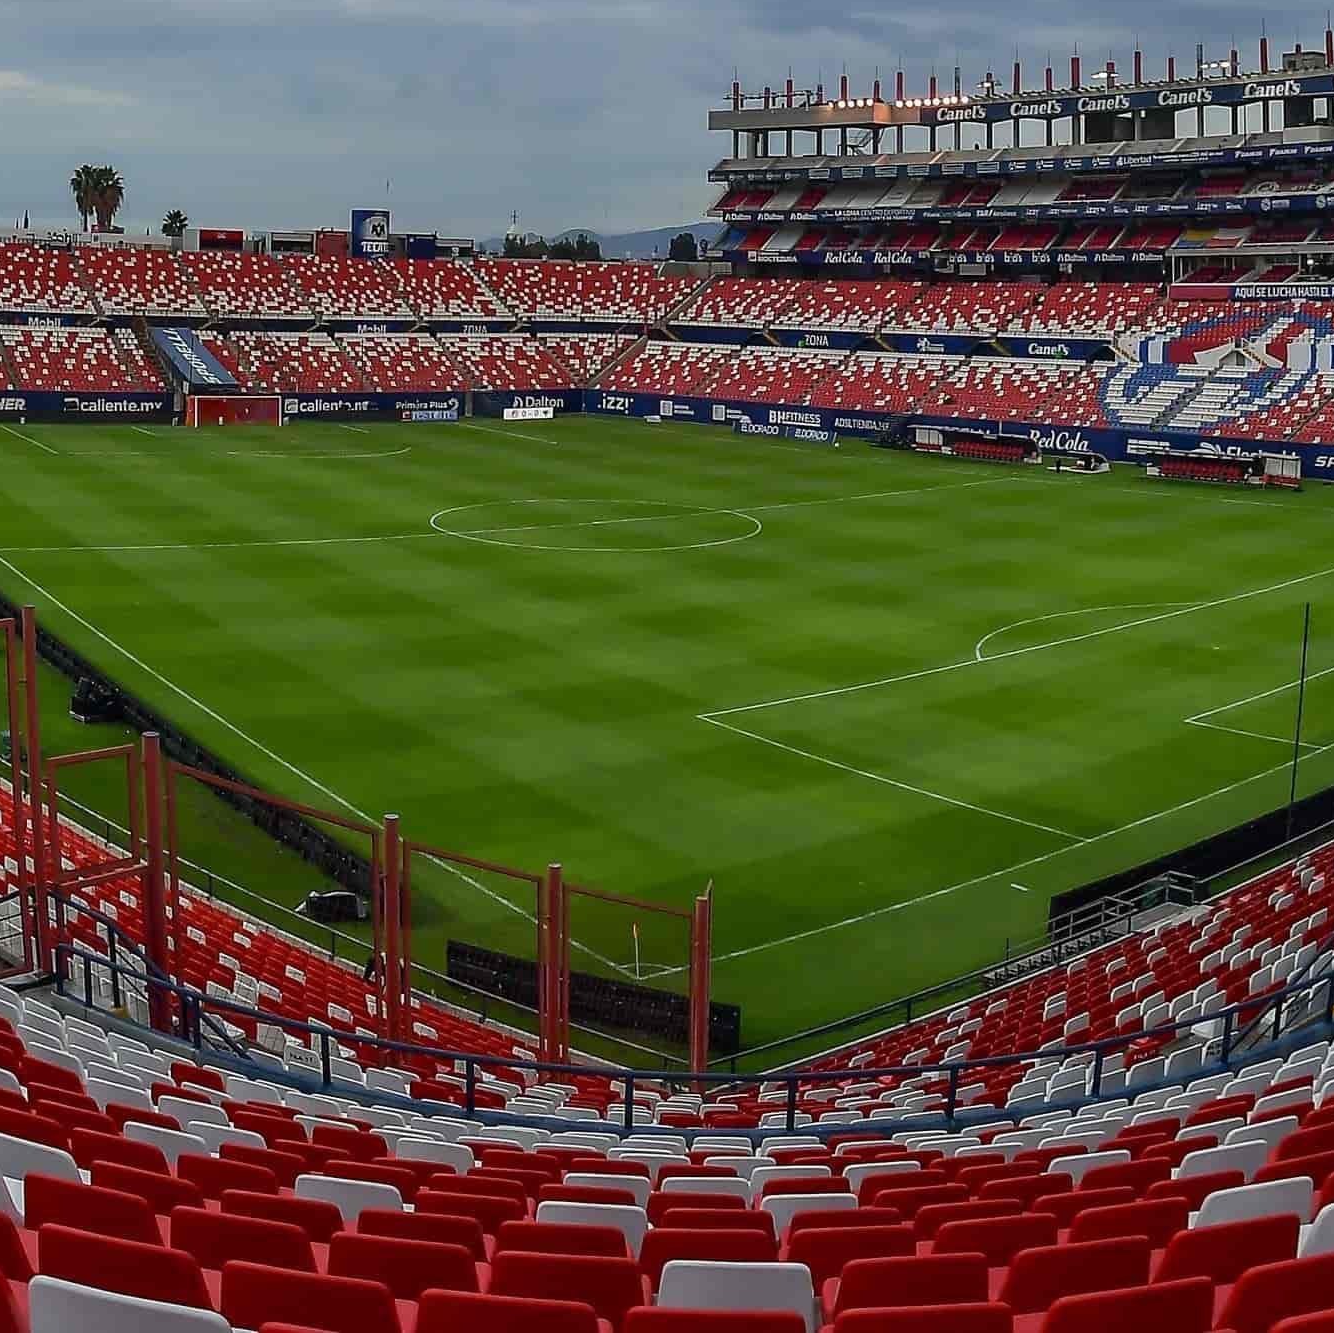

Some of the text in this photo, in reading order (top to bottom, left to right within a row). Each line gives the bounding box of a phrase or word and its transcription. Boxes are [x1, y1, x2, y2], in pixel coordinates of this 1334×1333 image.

[1158, 88, 1213, 106] Canel's
[1244, 81, 1301, 100] Canel's
[1010, 100, 1062, 116] Canel's
[1077, 95, 1131, 112] Canel's
[936, 105, 987, 121] Canel's
[525, 396, 564, 408] Dalton
